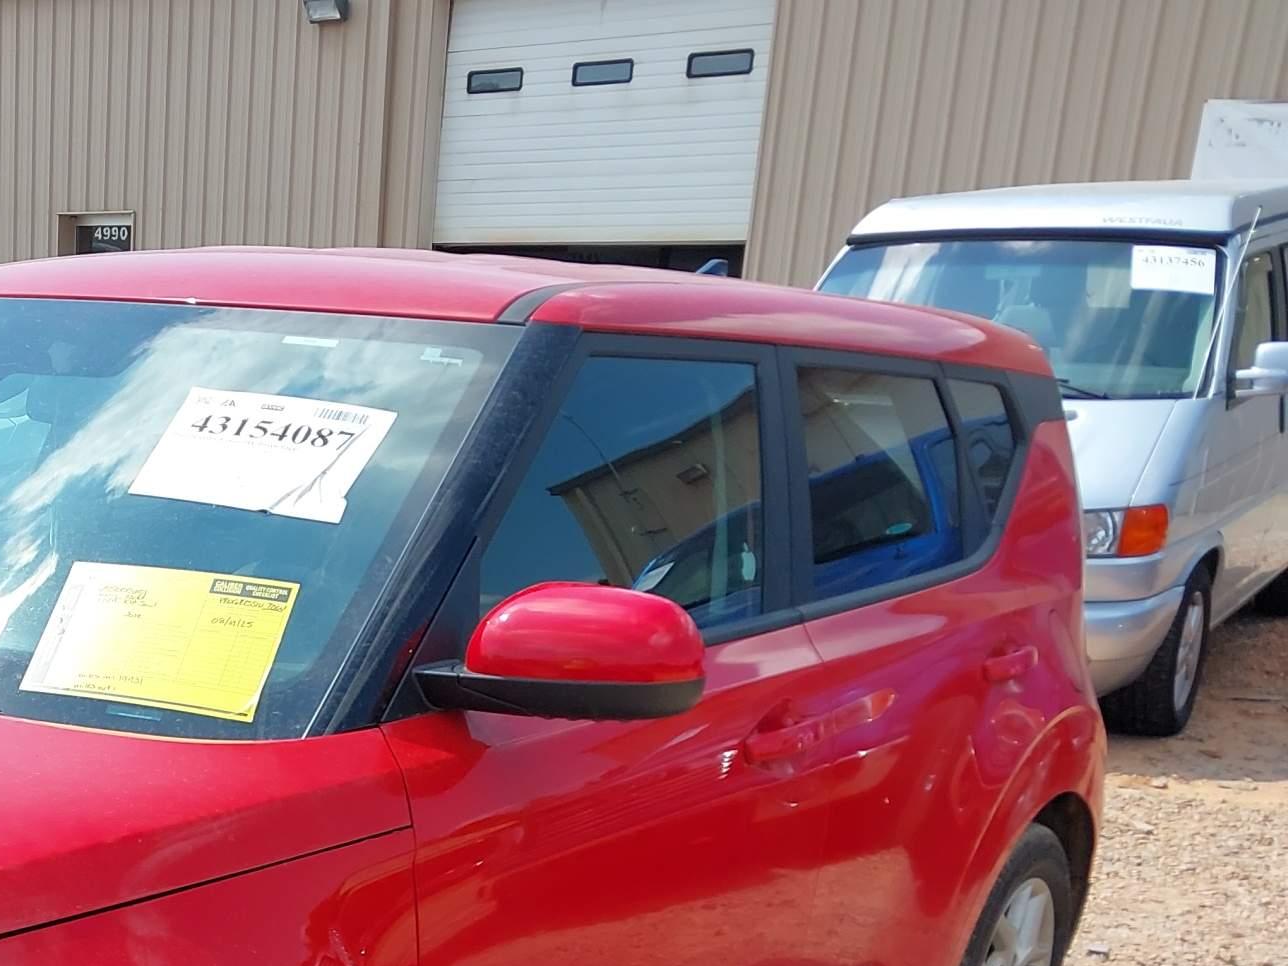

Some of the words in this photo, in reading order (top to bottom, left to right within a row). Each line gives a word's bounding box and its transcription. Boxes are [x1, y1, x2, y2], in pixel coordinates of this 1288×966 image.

[94, 226, 129, 241] 4990
[1142, 255, 1206, 267] 43137456
[191, 414, 356, 451] 43154087
